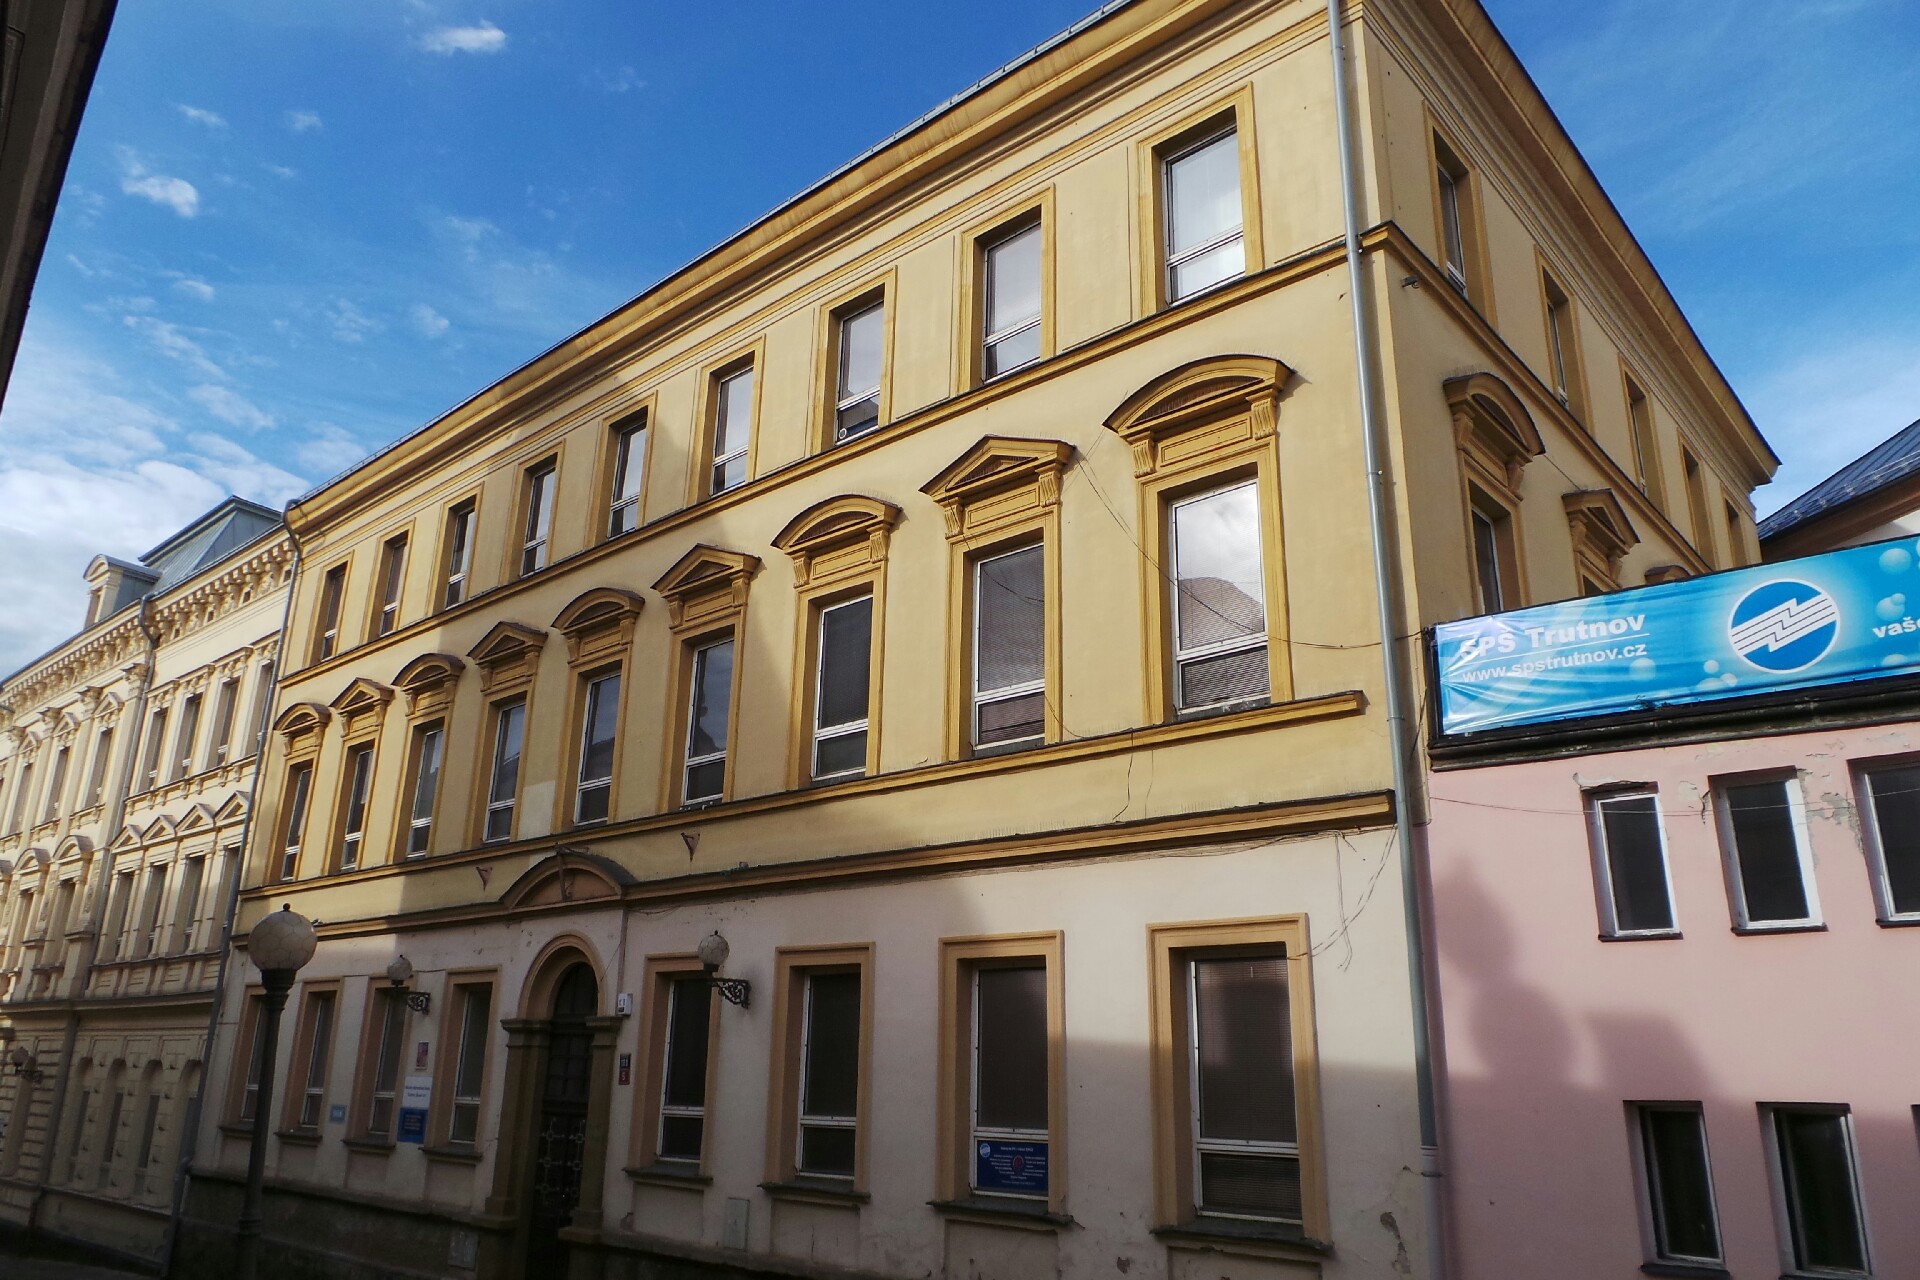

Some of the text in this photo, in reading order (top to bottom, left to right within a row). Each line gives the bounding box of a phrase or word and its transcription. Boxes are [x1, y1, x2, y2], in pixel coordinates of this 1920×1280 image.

[1525, 614, 1646, 648] Trutnov
[1871, 616, 1920, 638] vaš
[1462, 643, 1648, 683] www.spstrutnov.cz
